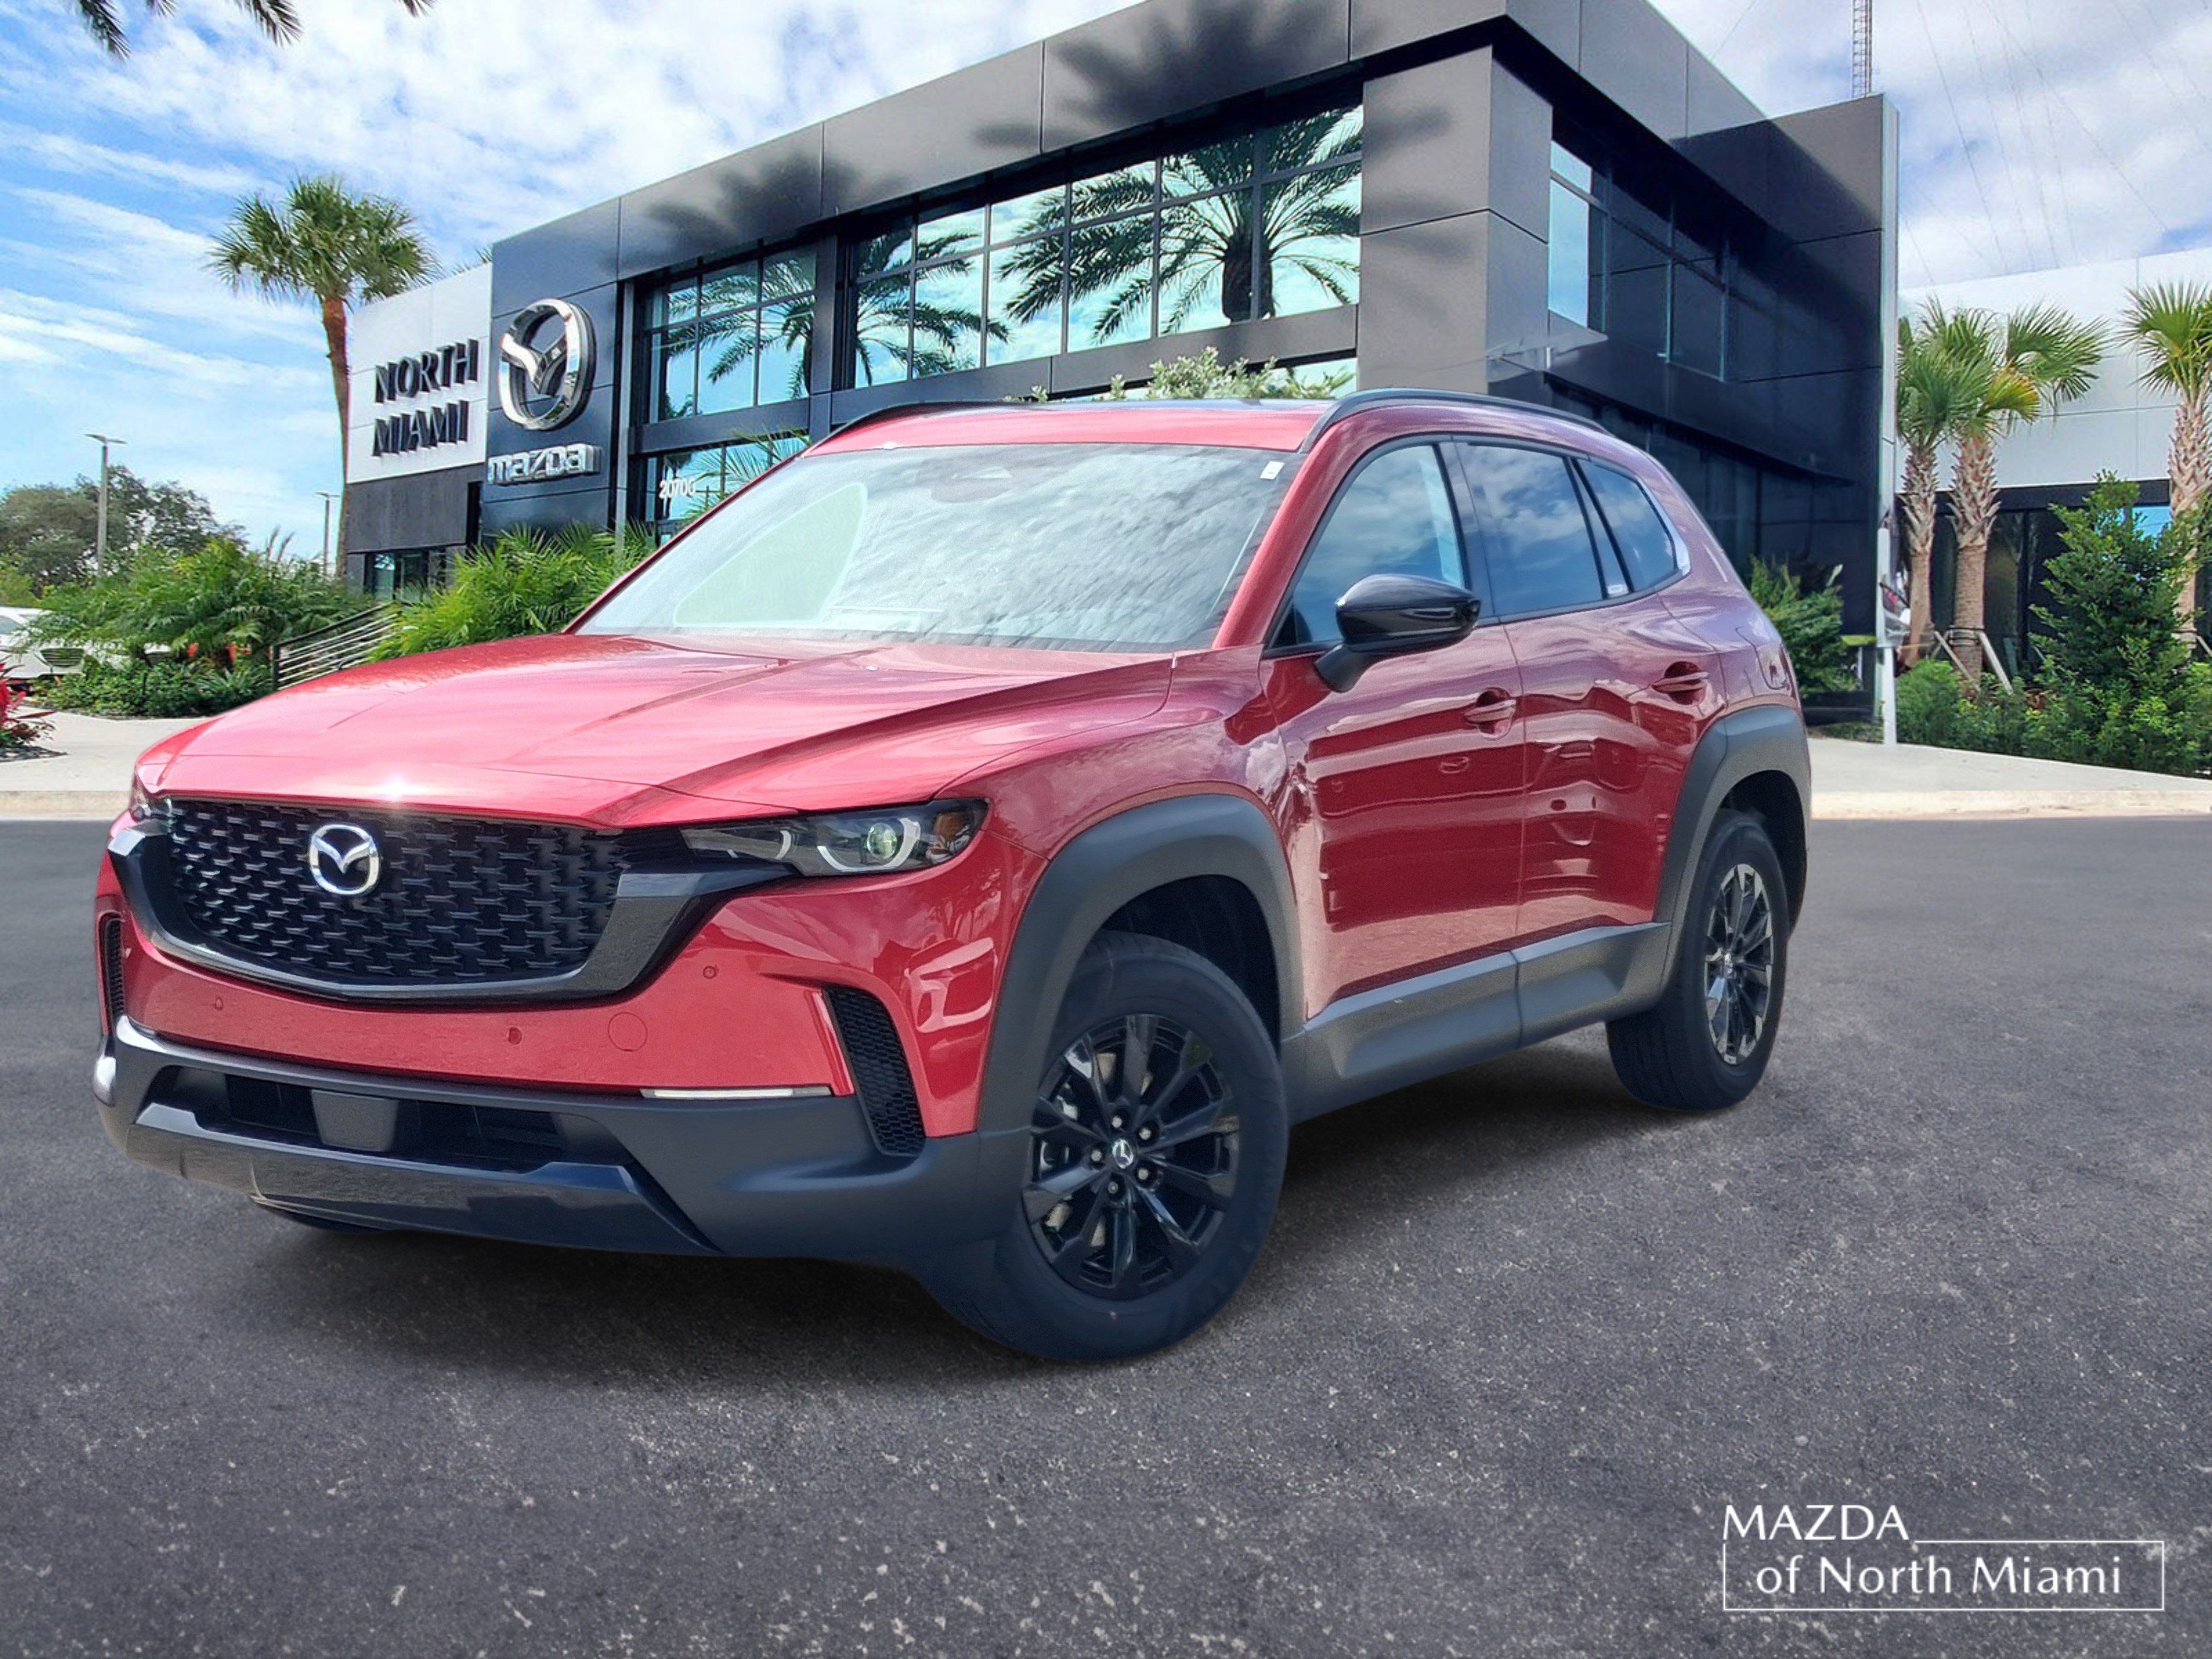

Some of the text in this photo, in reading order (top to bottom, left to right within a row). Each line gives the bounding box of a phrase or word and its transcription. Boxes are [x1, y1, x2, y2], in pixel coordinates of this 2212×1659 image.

[375, 339, 479, 404] NORTH
[372, 400, 468, 457] MIAMI
[488, 444, 597, 484] mazda
